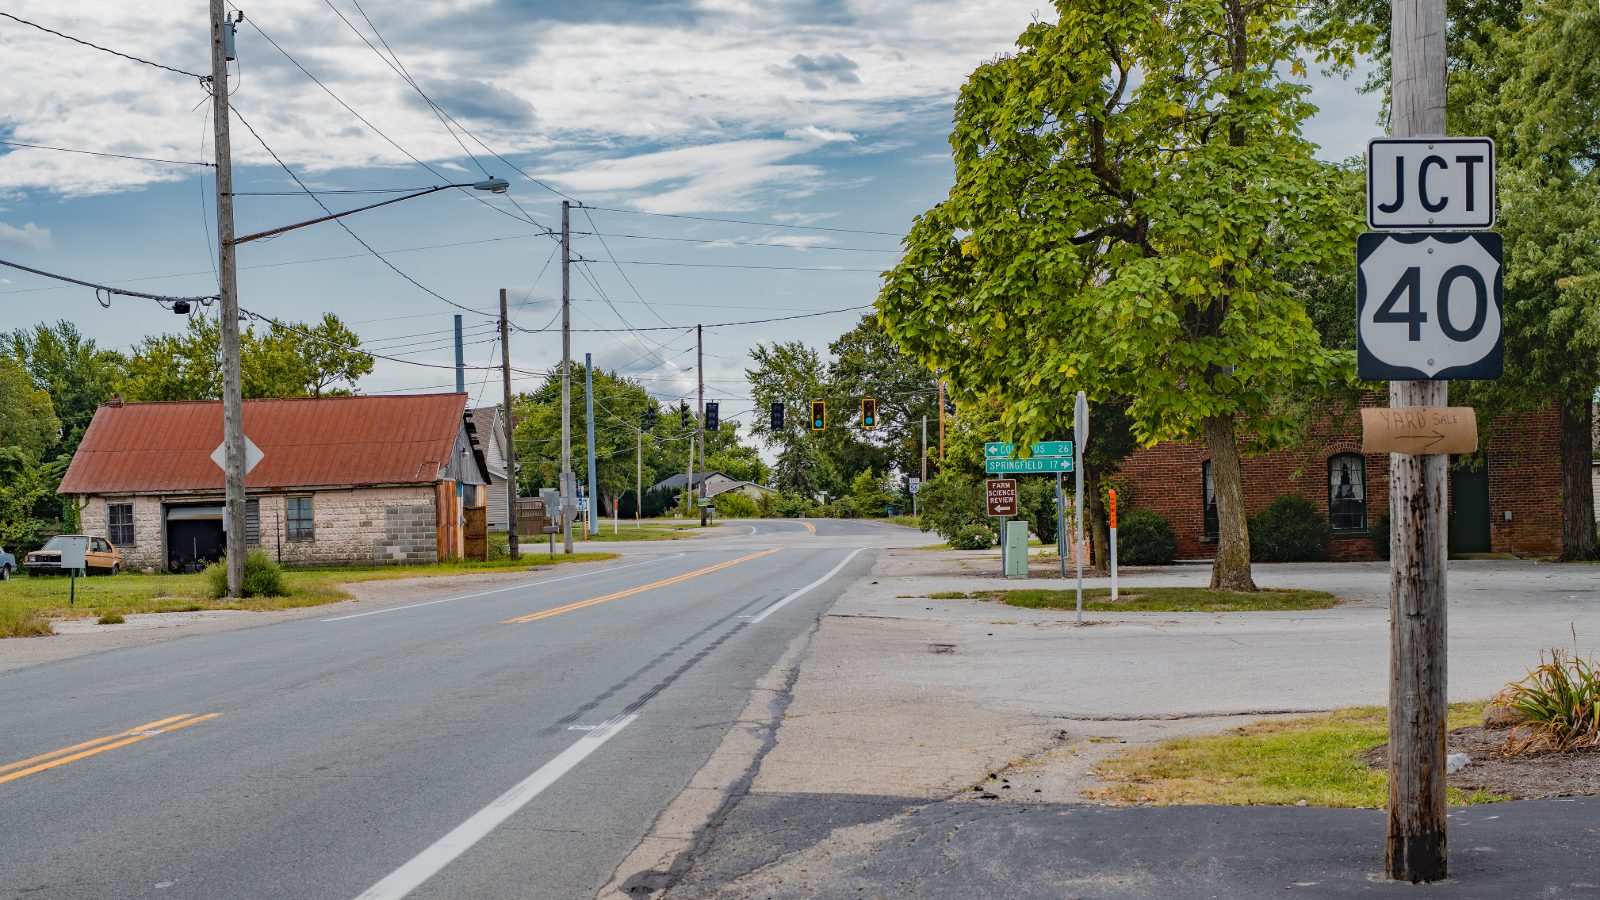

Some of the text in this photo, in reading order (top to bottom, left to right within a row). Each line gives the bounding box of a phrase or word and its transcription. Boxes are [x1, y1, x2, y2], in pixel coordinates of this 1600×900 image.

[1377, 155, 1484, 213] JCT
[1373, 264, 1487, 342] 40
[1379, 411, 1426, 430] YARD
[1001, 444, 1069, 454] COUS 26
[990, 461, 1058, 470] SPRINGFIELD 17
